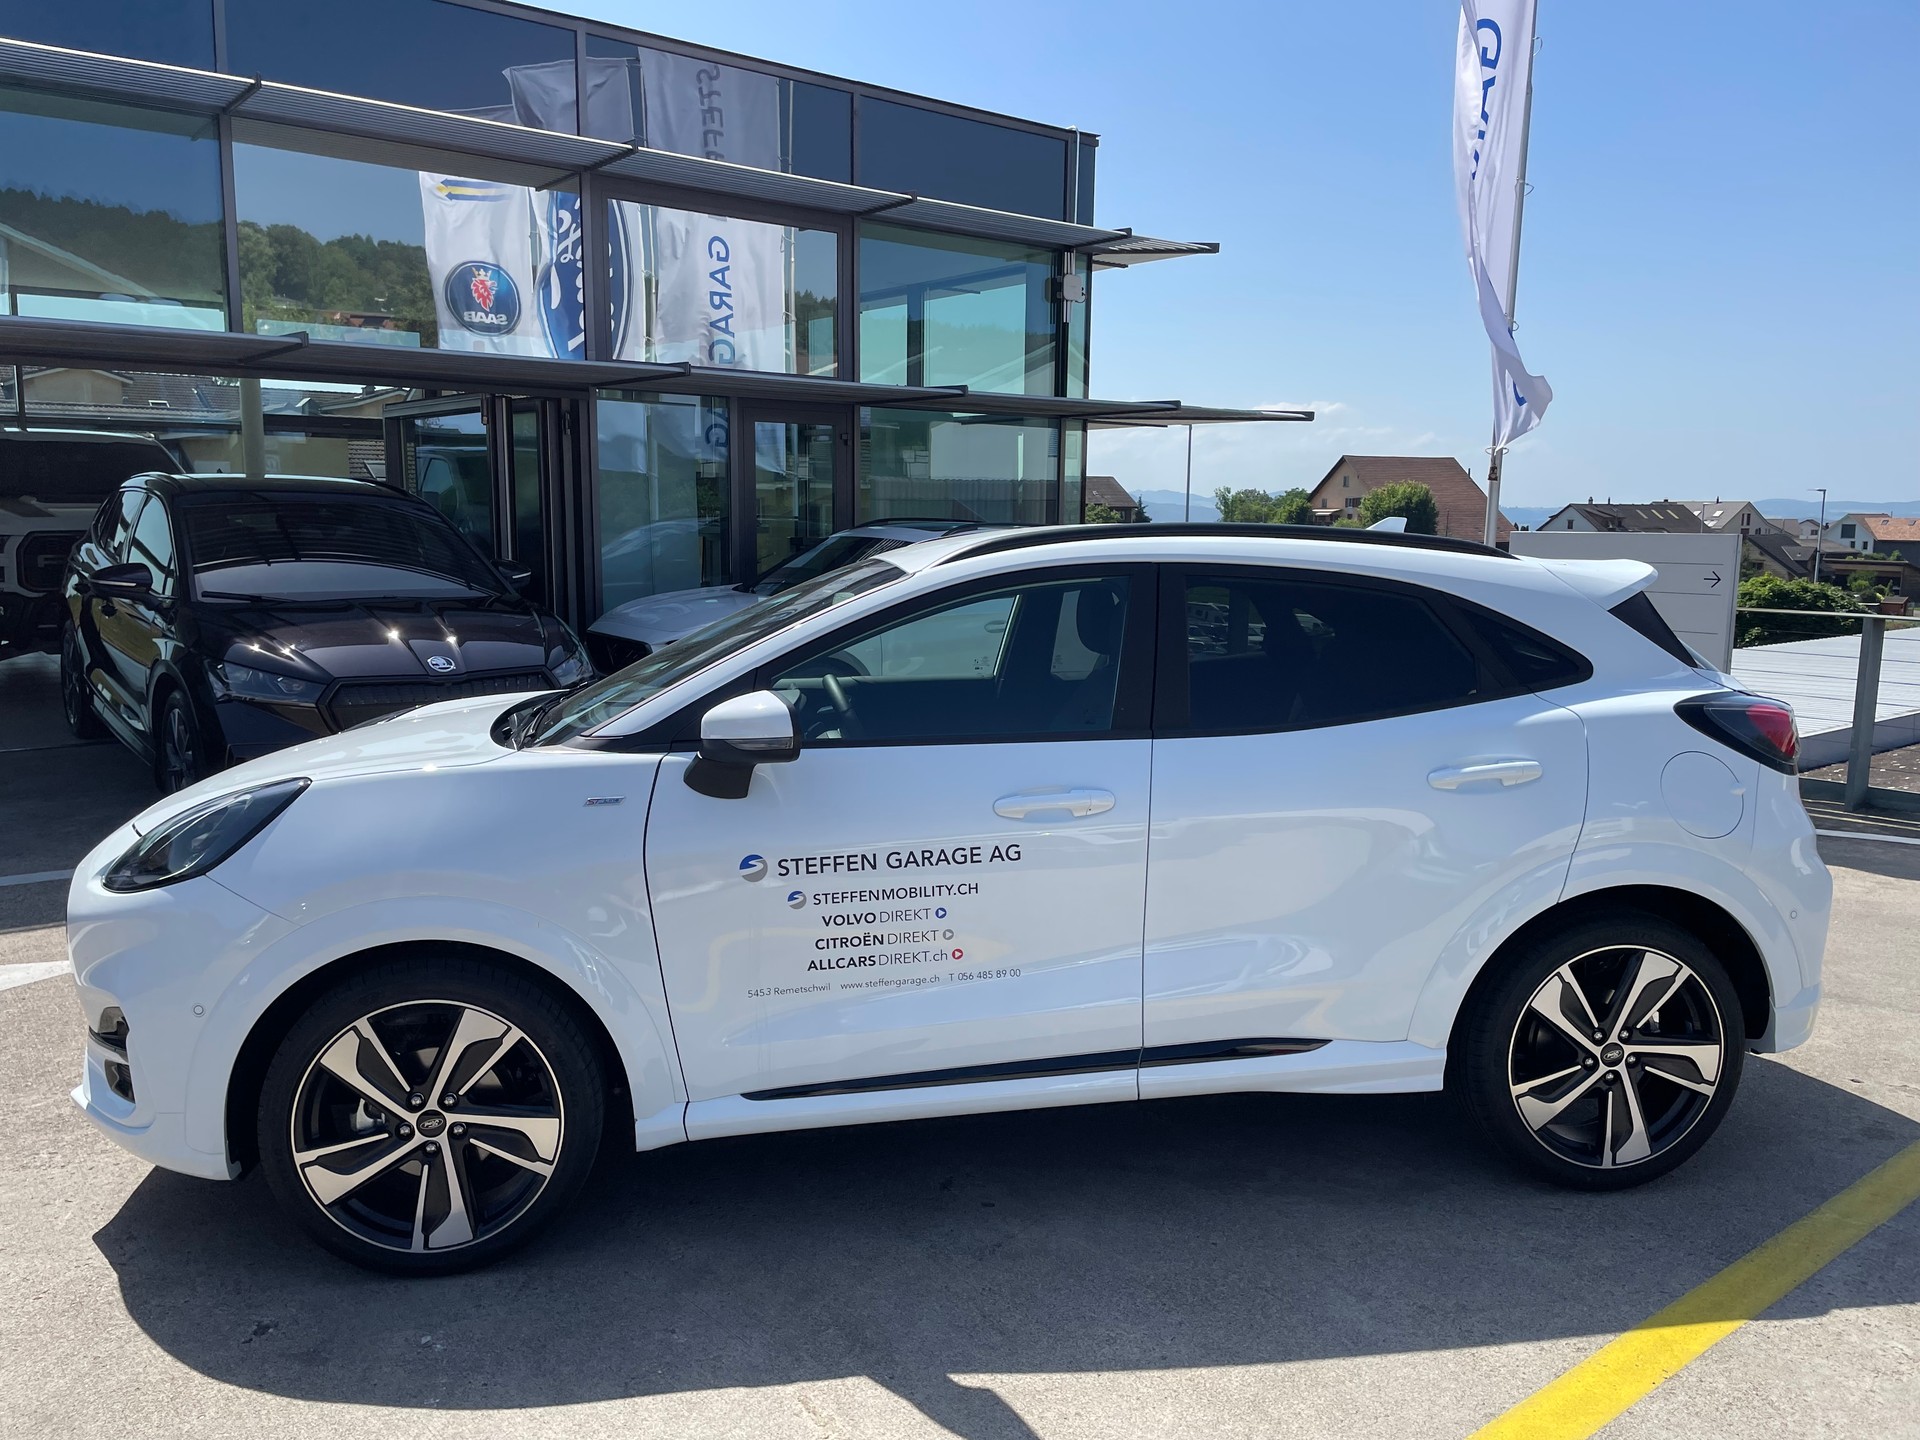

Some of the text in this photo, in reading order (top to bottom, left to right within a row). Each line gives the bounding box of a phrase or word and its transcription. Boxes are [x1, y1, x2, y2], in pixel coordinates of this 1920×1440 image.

[777, 844, 1022, 877] STEFFEN GARAGE AG
[812, 882, 979, 905] STEFFENMOBILITY.CH
[747, 988, 771, 998] 5453
[773, 982, 831, 996] Remetschwil
[840, 974, 940, 990] www.steffengarage.ch
[957, 971, 974, 981] 056
[976, 969, 993, 980] 485
[995, 969, 1008, 979] 89
[1009, 968, 1021, 978] 00
